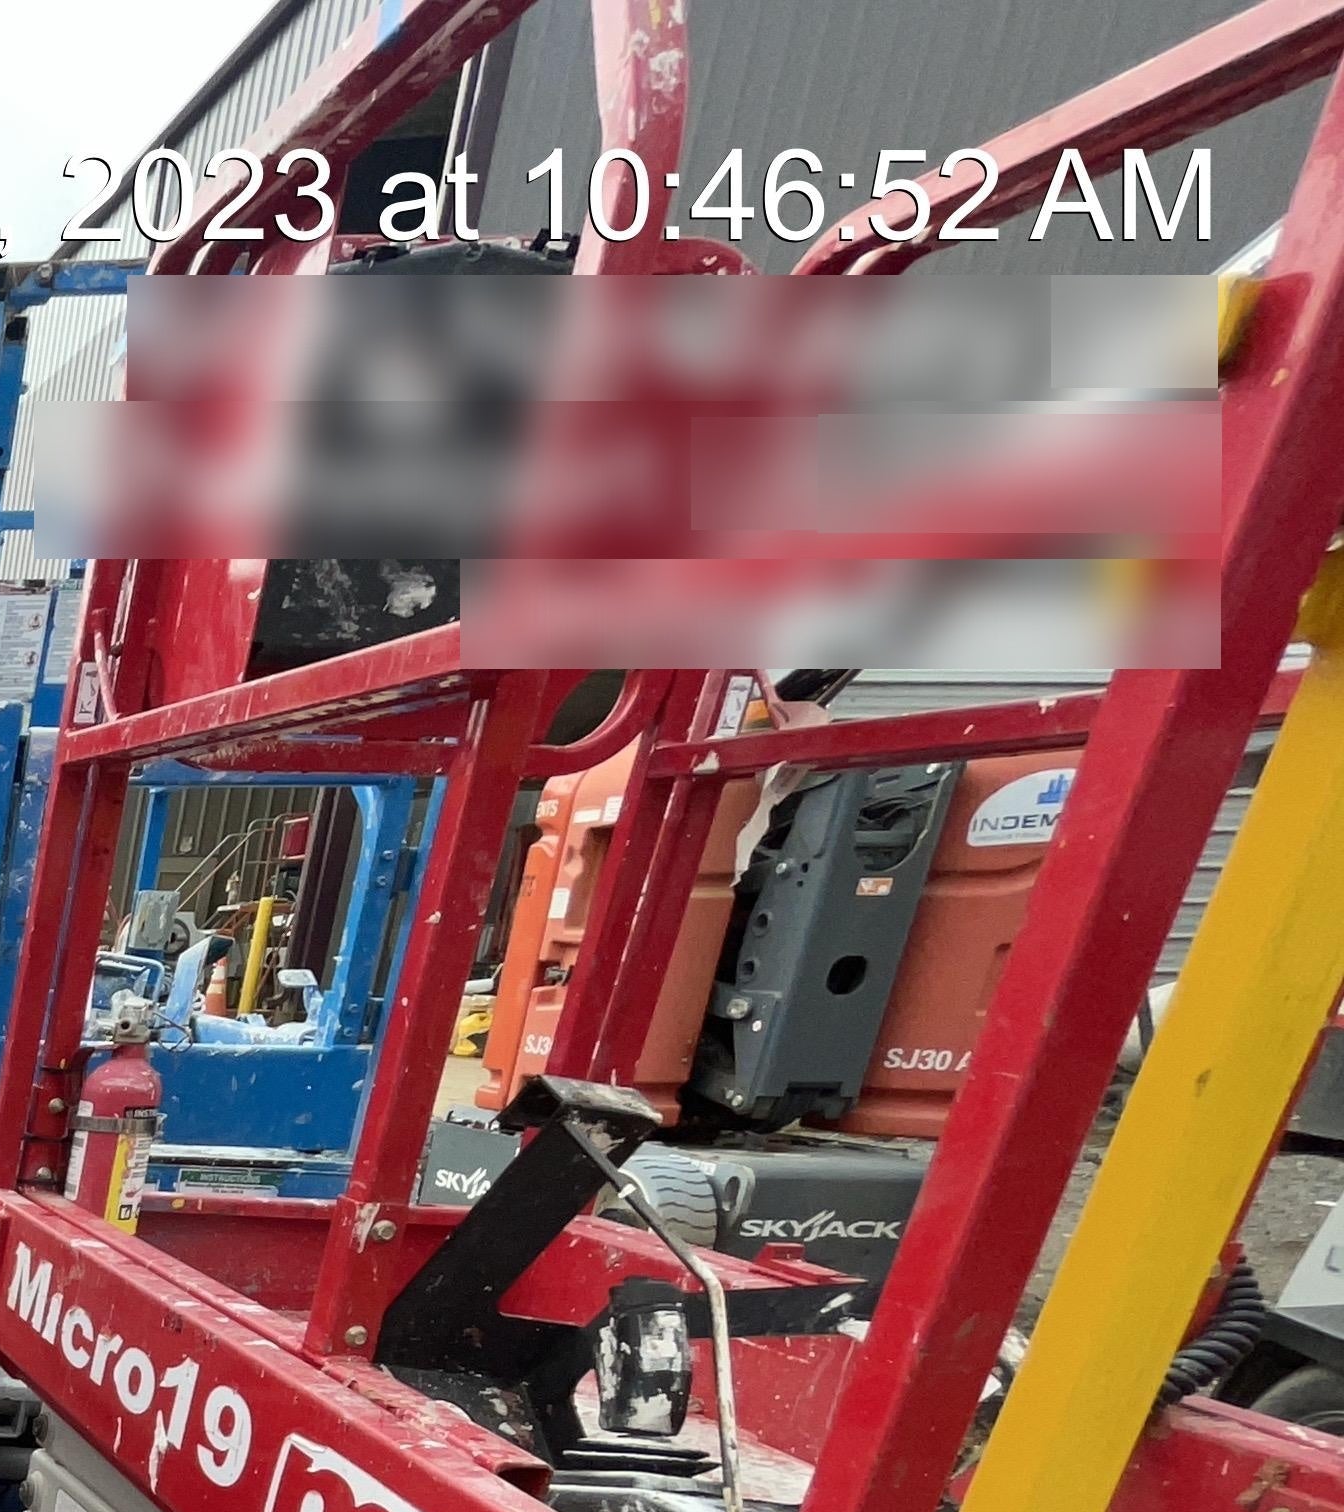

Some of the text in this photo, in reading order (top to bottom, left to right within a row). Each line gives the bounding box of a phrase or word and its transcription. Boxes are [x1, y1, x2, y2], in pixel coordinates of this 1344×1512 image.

[884, 1047, 952, 1071] SJ30
[739, 1209, 902, 1242] SKYJACK
[6, 1242, 254, 1488] Micro19
